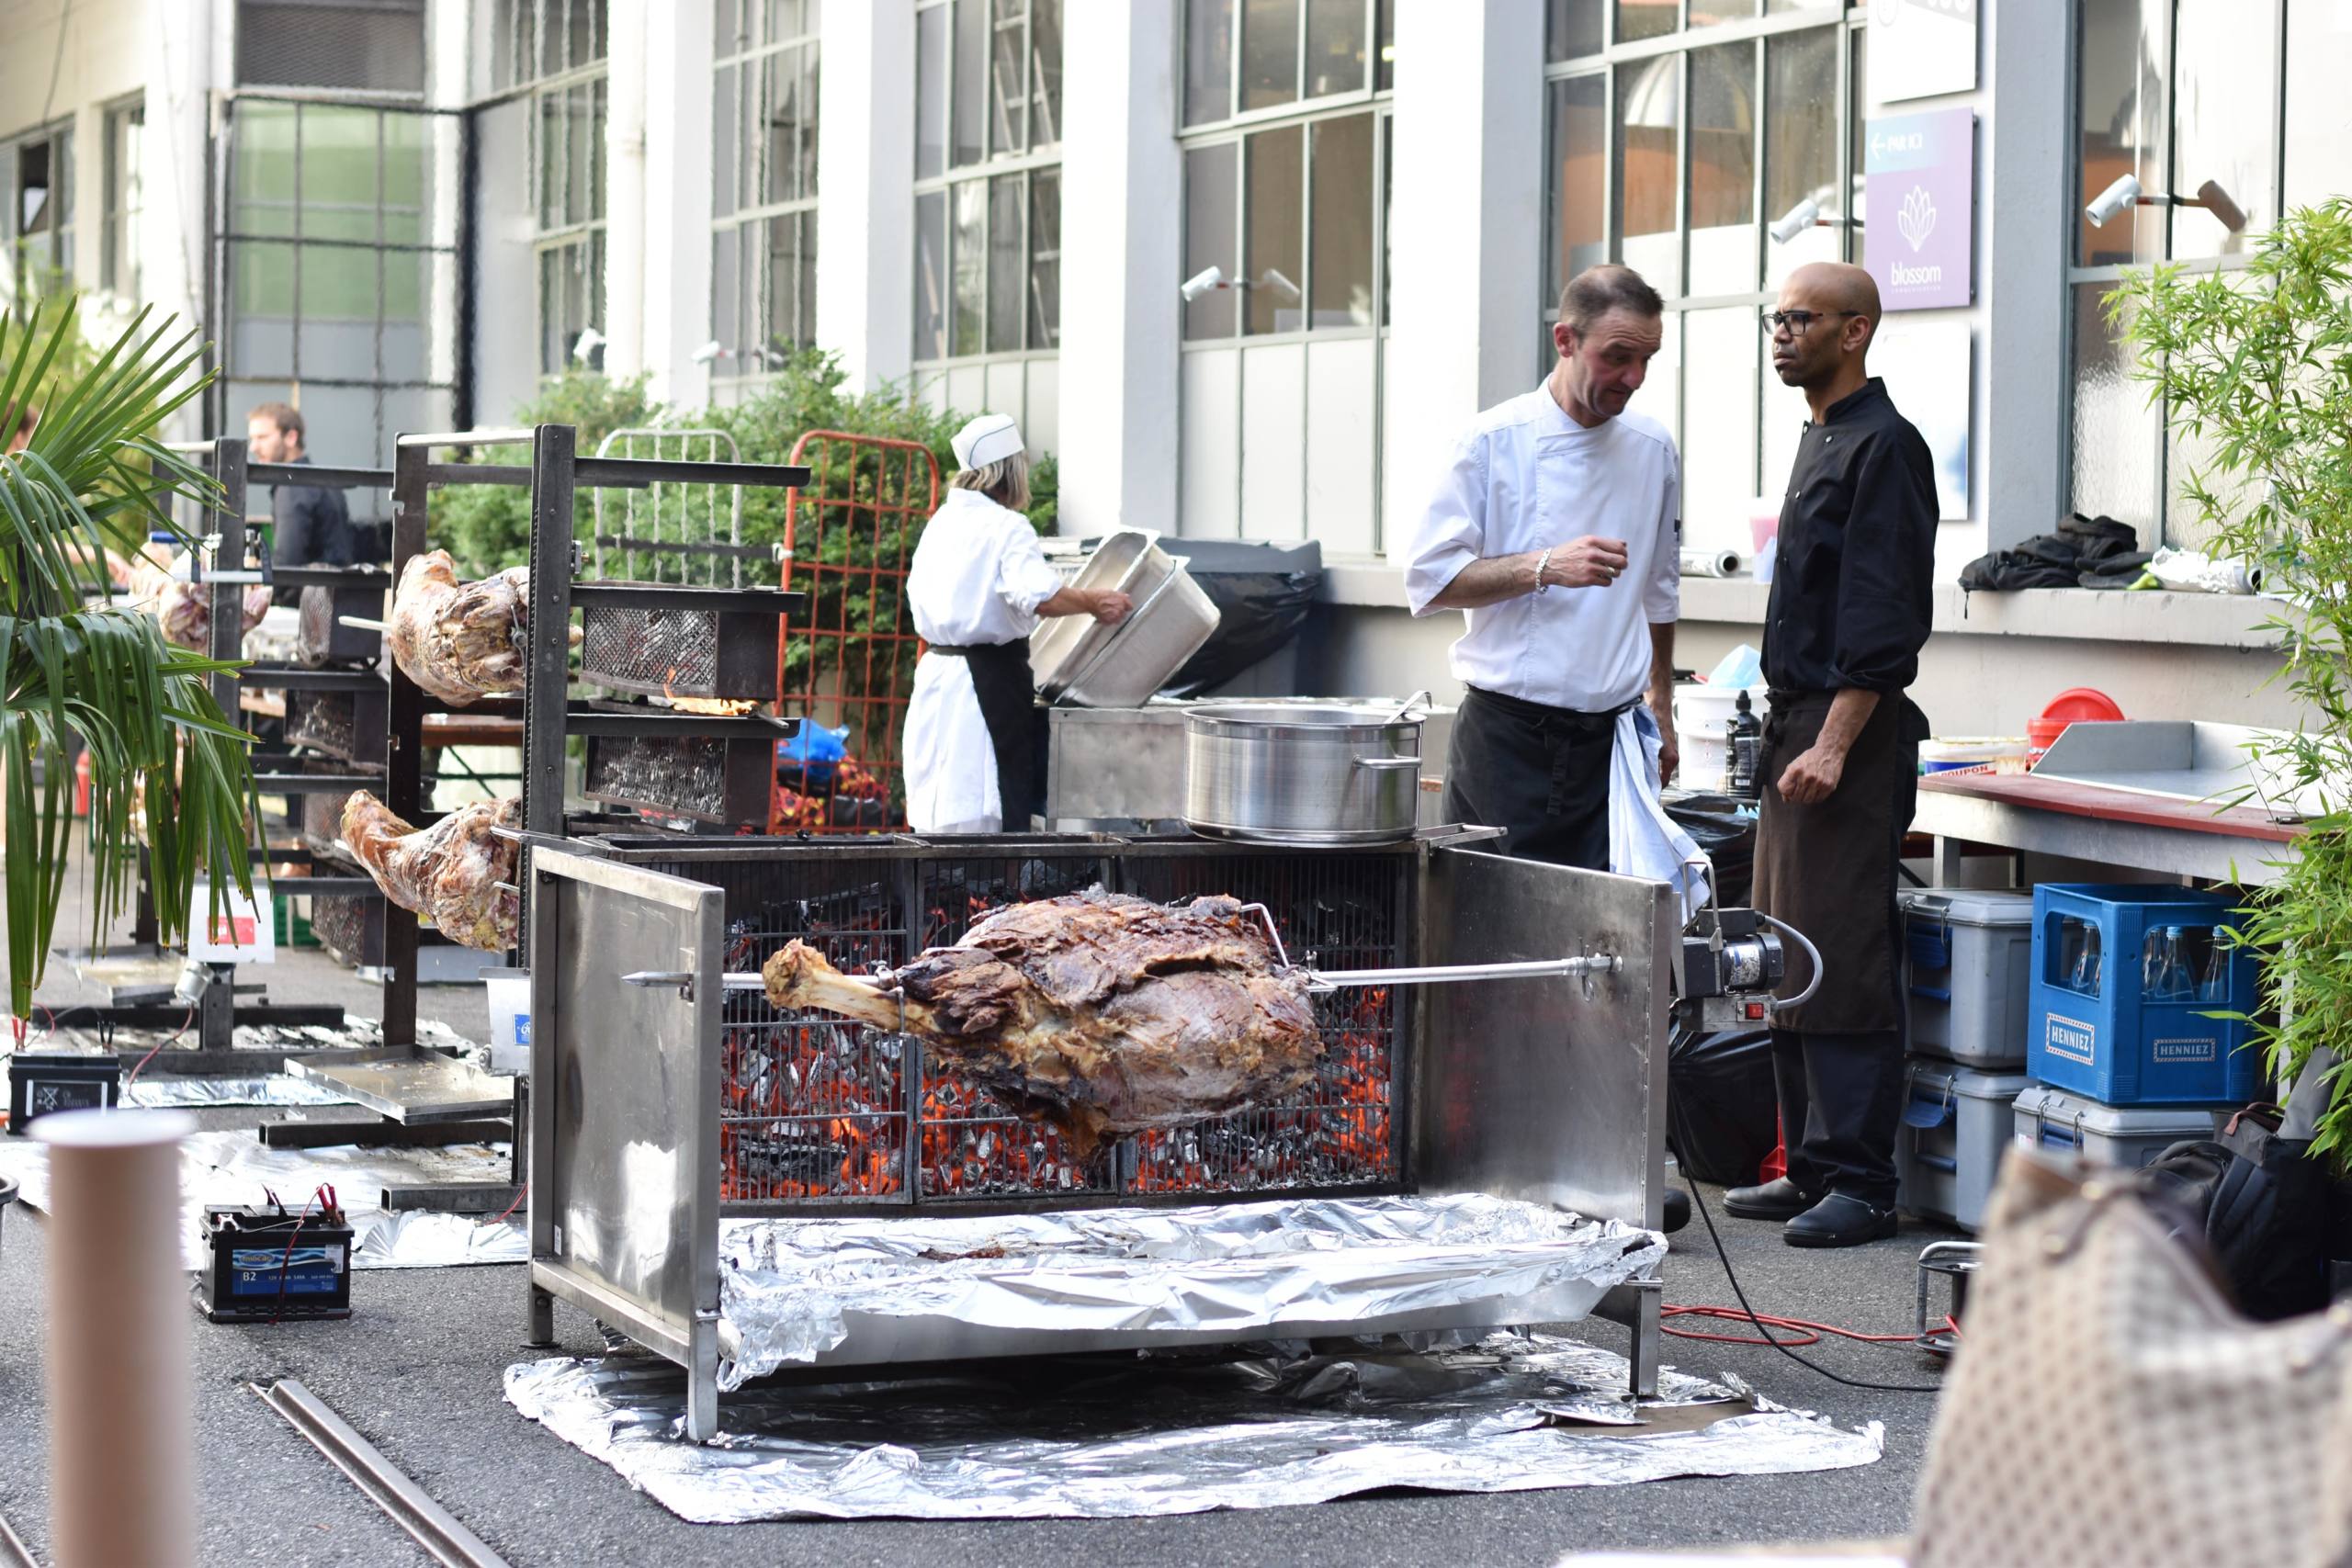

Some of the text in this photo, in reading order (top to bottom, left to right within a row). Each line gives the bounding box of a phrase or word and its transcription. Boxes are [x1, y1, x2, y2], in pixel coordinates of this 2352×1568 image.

[1891, 261, 1941, 286] blossom
[2052, 1025, 2089, 1052] HENNIEZ
[2160, 1043, 2209, 1055] HENNIEZ
[243, 1271, 256, 1281] B2
